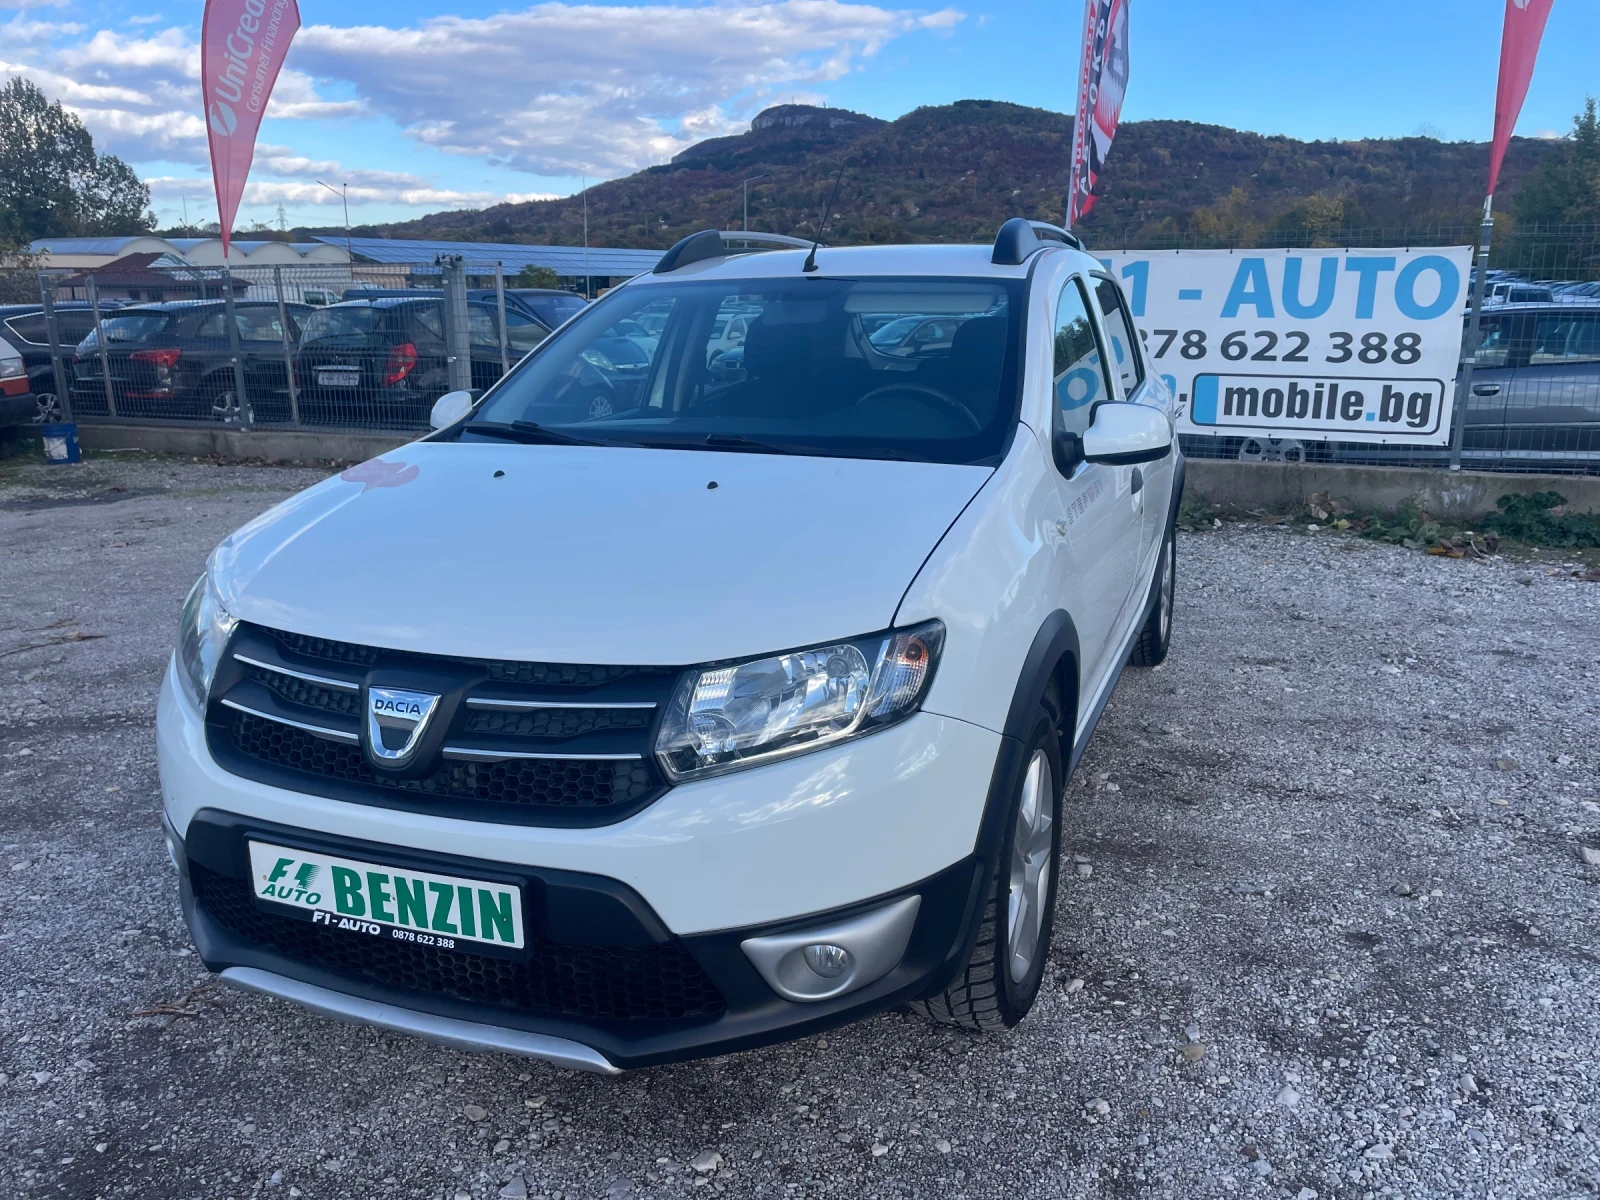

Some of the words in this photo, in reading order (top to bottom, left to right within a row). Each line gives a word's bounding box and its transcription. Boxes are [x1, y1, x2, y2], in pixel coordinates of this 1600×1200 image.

[215, 0, 266, 103] UniCred
[246, 50, 269, 113] Consumer
[261, 0, 289, 52] Financing
[1099, 259, 1150, 317] 1
[1220, 255, 1461, 320] AUTO
[1220, 330, 1309, 363] 622
[1325, 332, 1422, 364] 388
[1223, 381, 1432, 429] mobile.bg
[374, 699, 421, 715] DACIA
[261, 883, 321, 905] AUTO
[267, 858, 322, 890] F1
[331, 865, 515, 944] BENZIN
[312, 910, 381, 935] F1-AUTO
[392, 929, 415, 942] 0878
[417, 933, 434, 945] 622
[437, 936, 455, 949] 388
